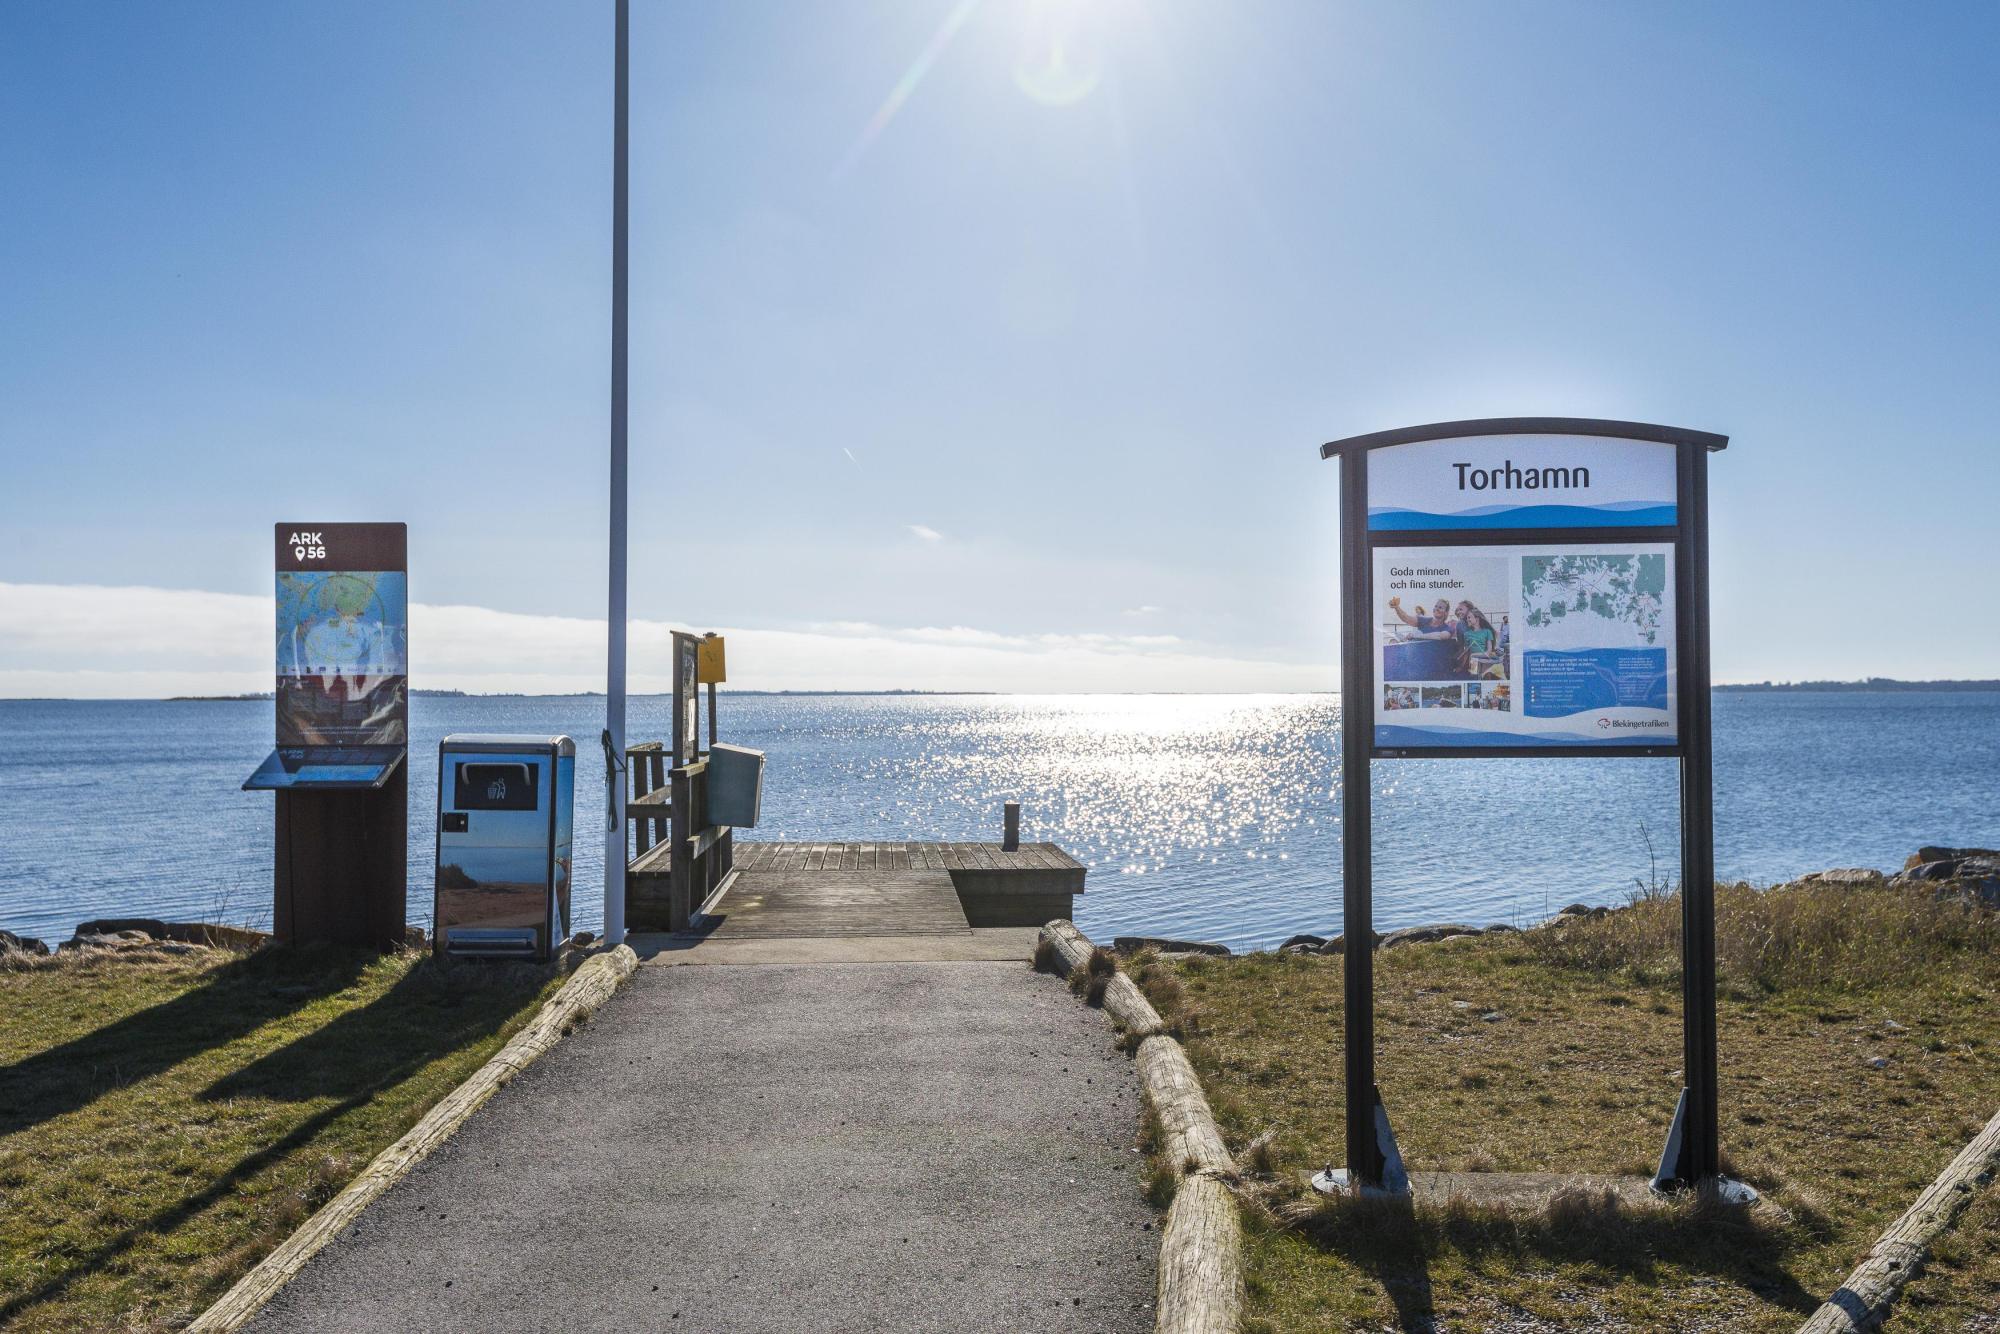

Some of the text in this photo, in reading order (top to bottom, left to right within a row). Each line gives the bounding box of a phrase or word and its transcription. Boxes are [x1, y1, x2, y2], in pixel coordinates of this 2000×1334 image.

[1452, 459, 1590, 490] Torhamn
[289, 532, 323, 545] ARK
[307, 546, 326, 559] 56
[1390, 566, 1450, 577] Goda minnen
[1390, 579, 1465, 589] och fina stunder.
[1612, 719, 1669, 729] Blekingetrafiken
